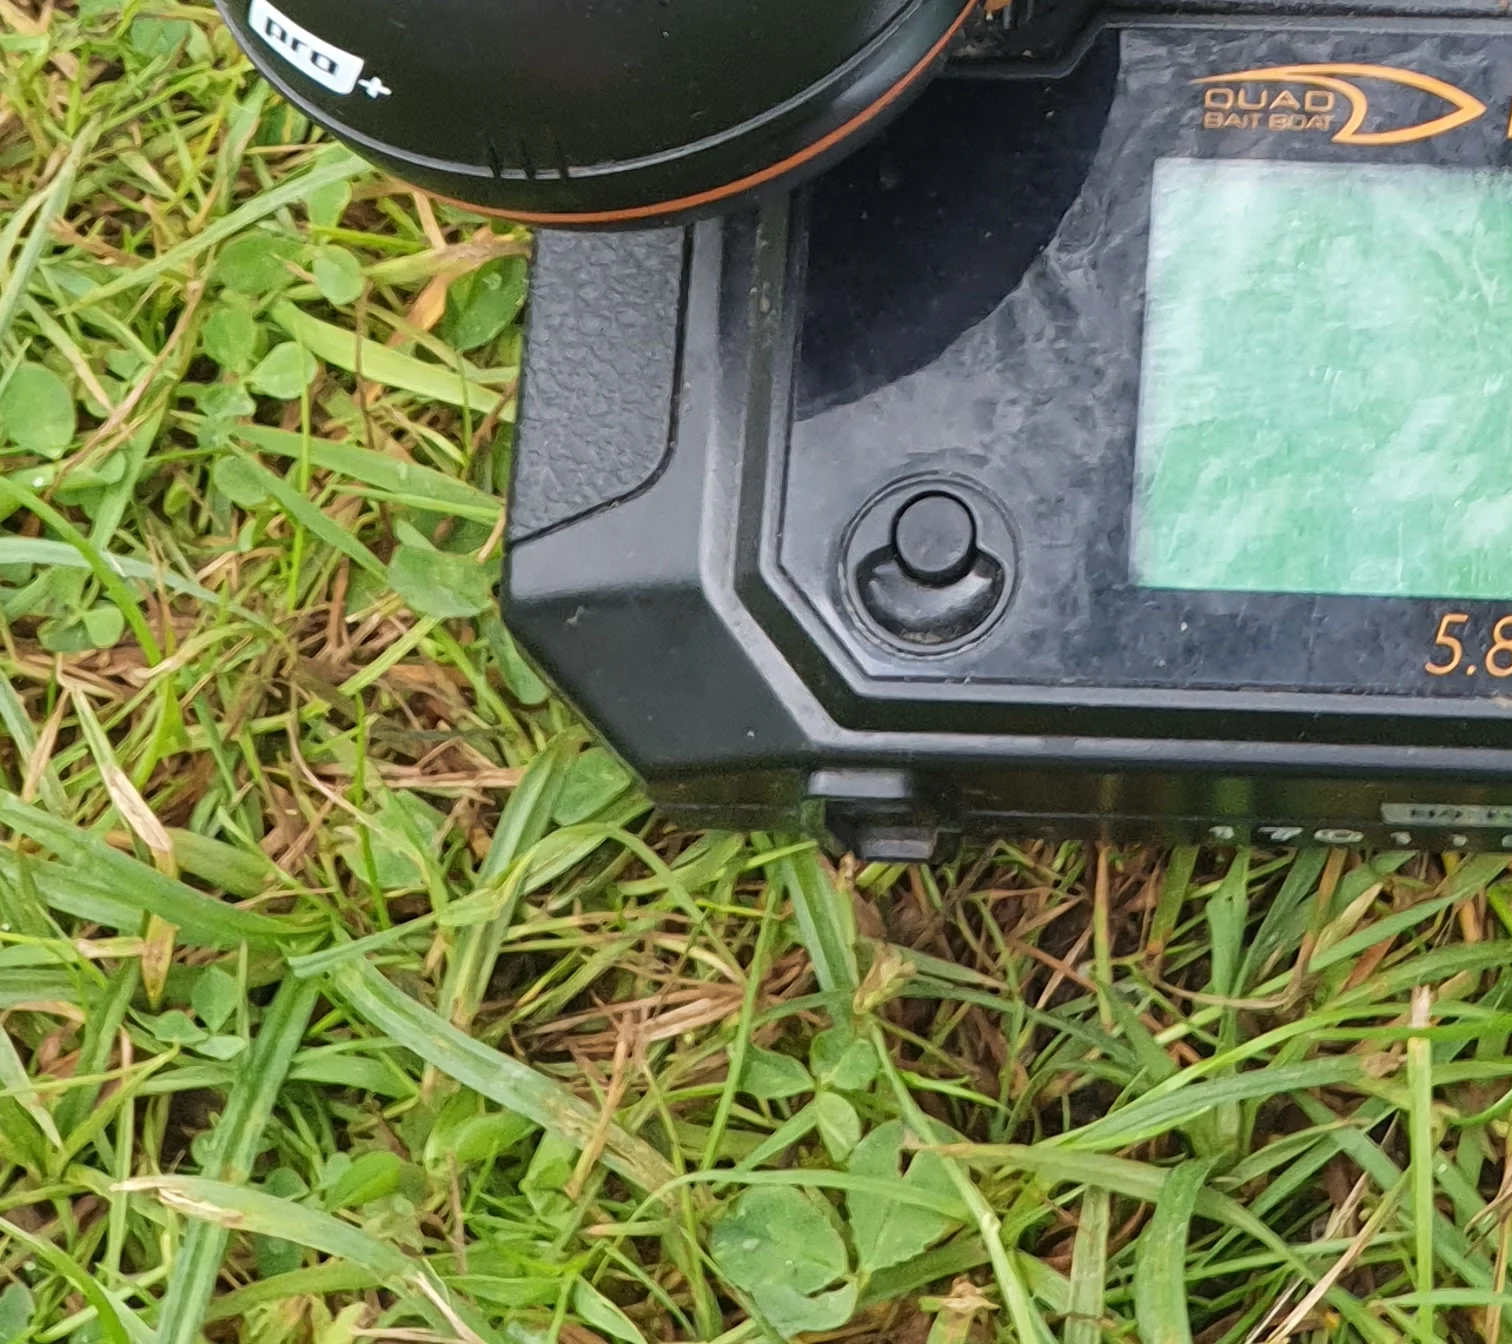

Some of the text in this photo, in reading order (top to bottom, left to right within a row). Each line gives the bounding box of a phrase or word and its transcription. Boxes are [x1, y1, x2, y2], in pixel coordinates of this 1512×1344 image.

[1203, 86, 1336, 113] QUAD
[1203, 112, 1336, 133] BAIT BOAT
